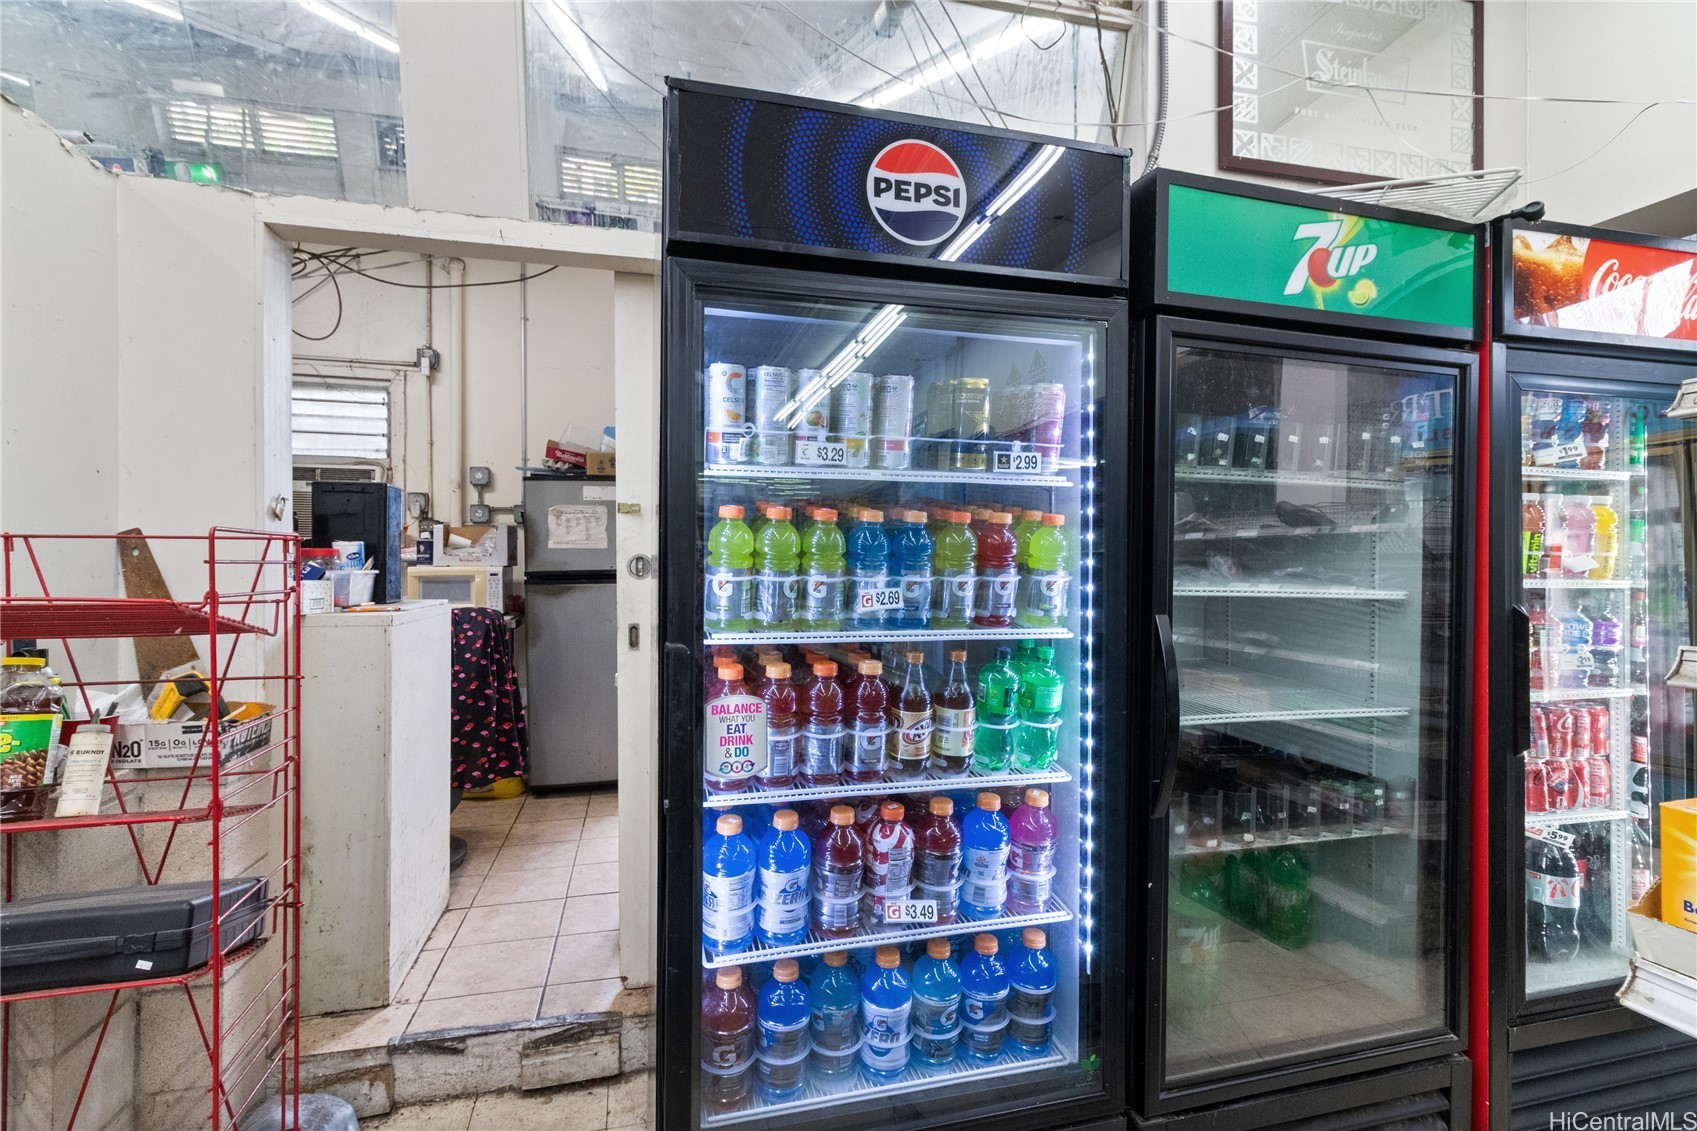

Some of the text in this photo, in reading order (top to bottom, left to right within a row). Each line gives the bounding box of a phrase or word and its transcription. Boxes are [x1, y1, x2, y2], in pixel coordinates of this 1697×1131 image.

[873, 176, 961, 209] PEPSI
[1282, 218, 1378, 296] 7UP
[817, 447, 844, 463] $3.29
[1013, 455, 1038, 470] $2.99
[876, 591, 900, 605] $2.69
[711, 703, 763, 715] BALANCE
[719, 715, 755, 724] WHAT YOU
[719, 735, 753, 747] DRINK
[724, 747, 749, 758] & DO
[905, 904, 934, 919] $3.49
[1683, 899, 1697, 914] B
